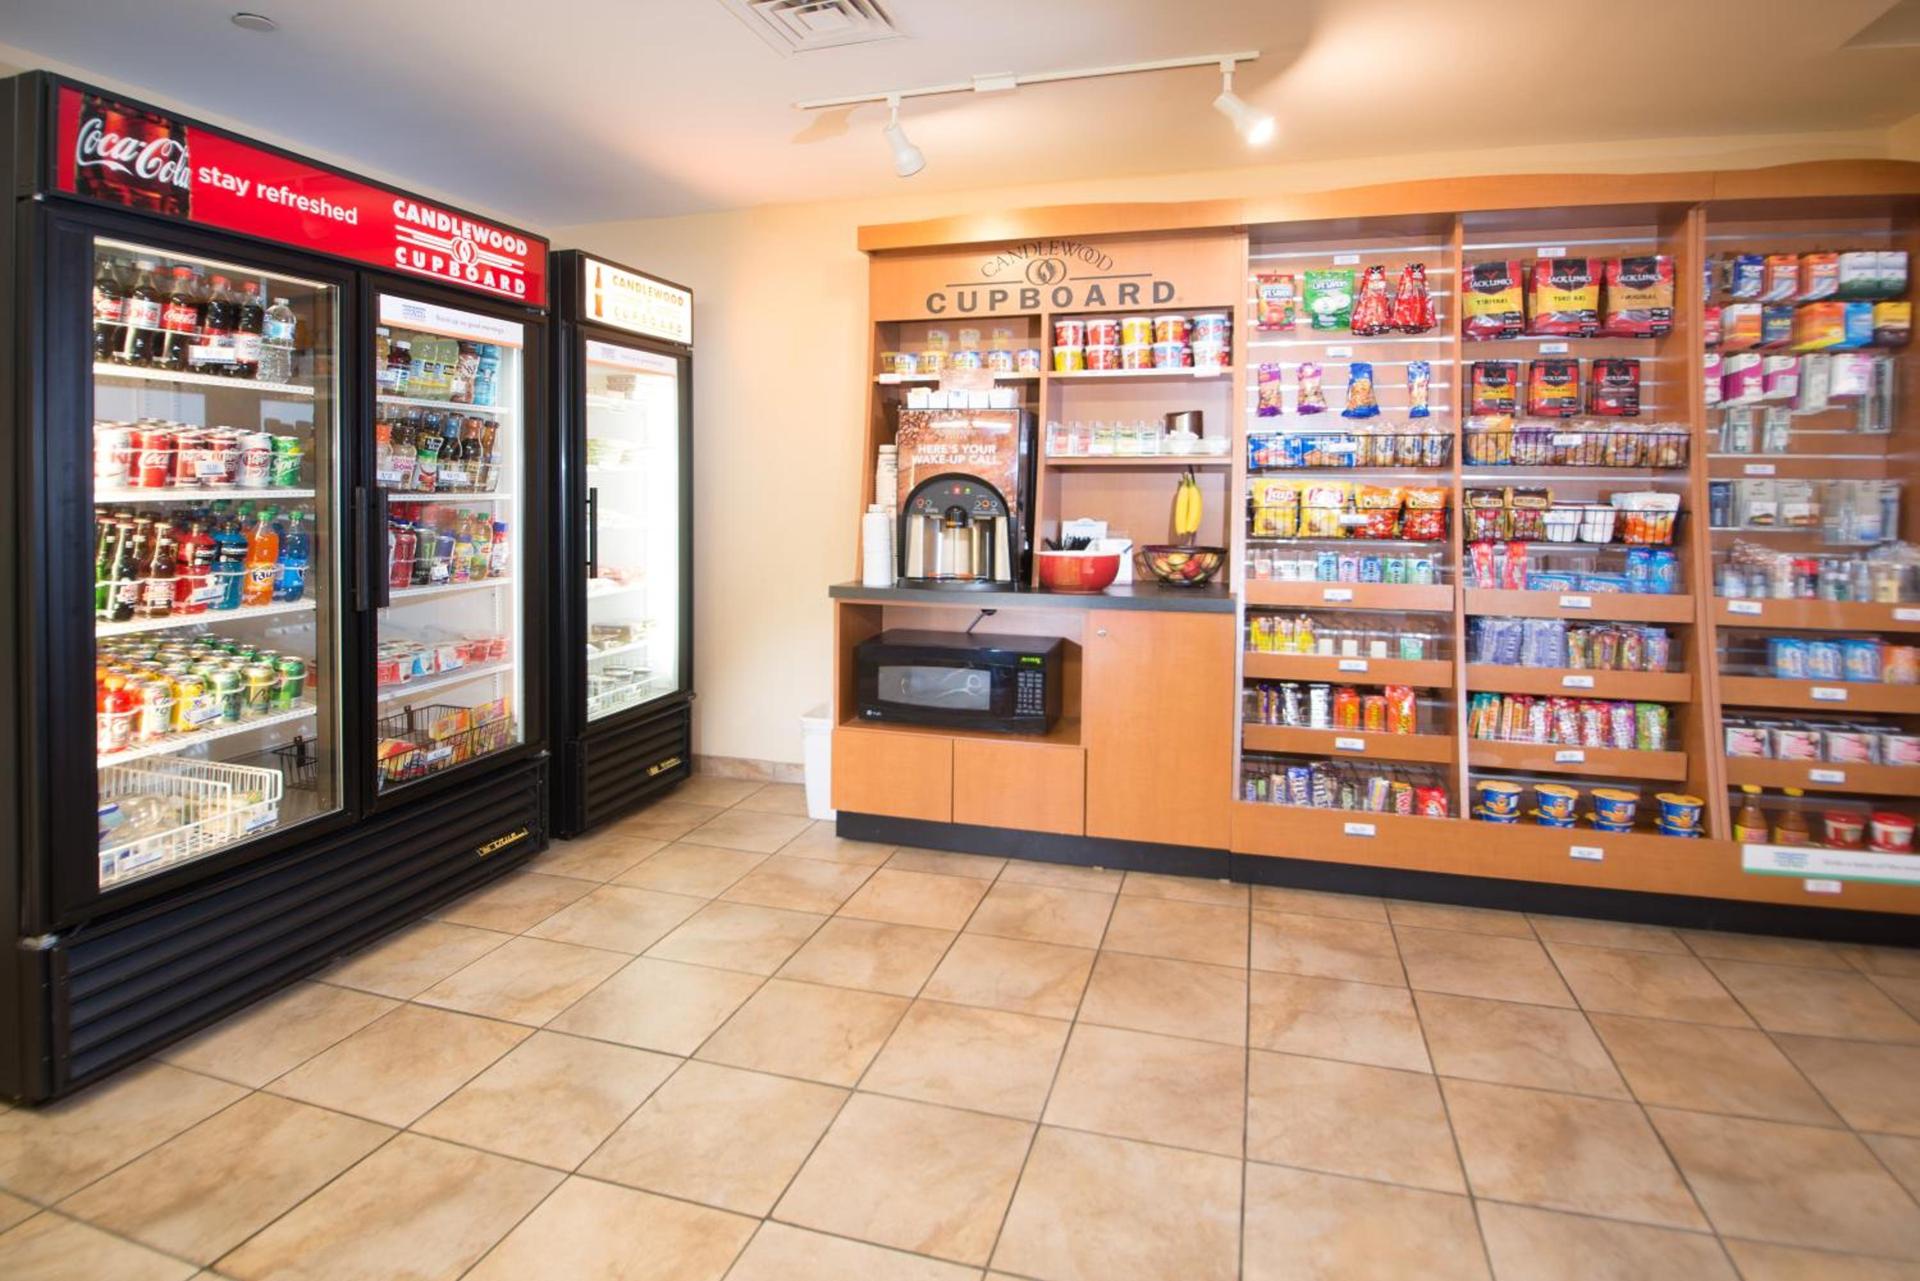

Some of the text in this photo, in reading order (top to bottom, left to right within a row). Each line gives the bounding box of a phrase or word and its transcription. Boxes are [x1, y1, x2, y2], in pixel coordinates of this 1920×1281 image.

[76, 117, 193, 189] Coca-Cola
[199, 165, 358, 226] stay refreshed
[393, 199, 527, 257] CANDLEWOOD
[395, 246, 526, 295] CUPBOARD
[980, 239, 1114, 278] CANDLEWOOD
[612, 274, 685, 307] CANDLEWOOD
[925, 279, 1176, 315] CUPBOARD
[614, 306, 684, 334] CUPBOARD
[912, 454, 964, 465] WAKE-UP
[918, 444, 997, 454] HERE'S YOUR
[252, 566, 278, 582] Fan
